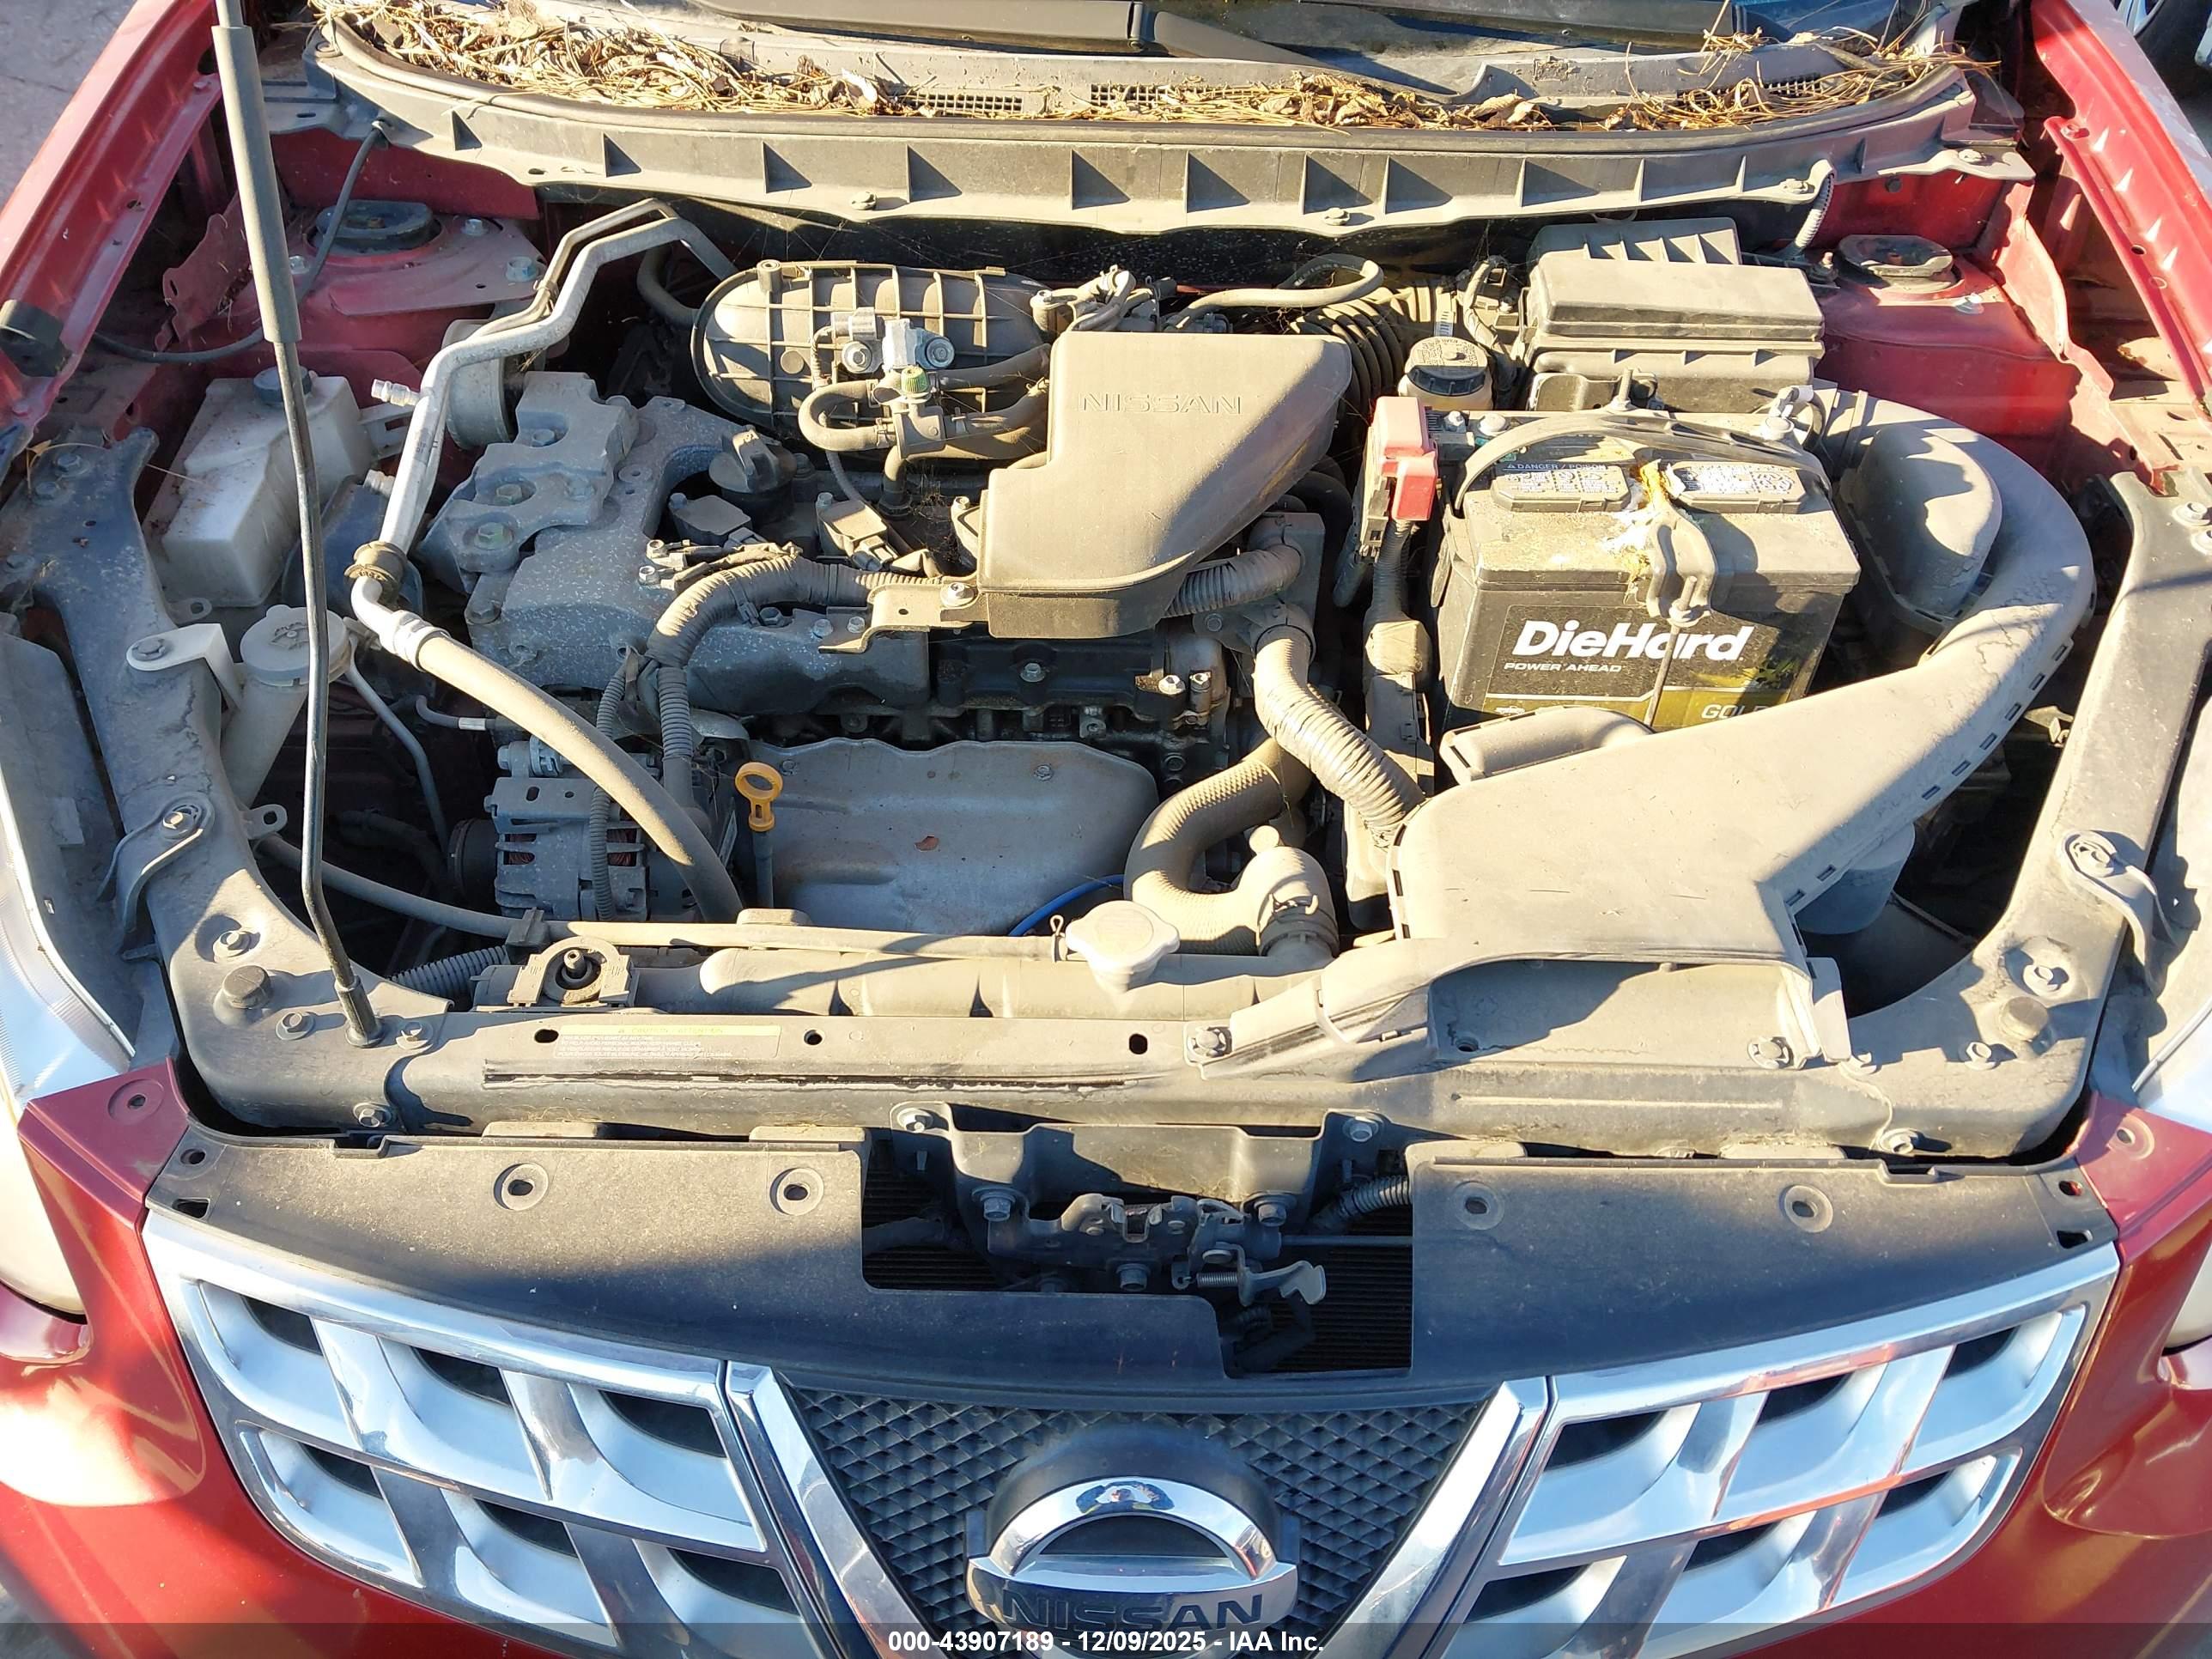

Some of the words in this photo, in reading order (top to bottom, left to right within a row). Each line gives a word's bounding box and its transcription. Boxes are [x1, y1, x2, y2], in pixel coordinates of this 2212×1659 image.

[1078, 392, 1244, 416] NISSAN
[1511, 619, 1755, 661] DieHard
[1504, 662, 1563, 672] POWER
[1565, 664, 1622, 673] AHEAD
[1002, 1589, 1263, 1634] NISSAN
